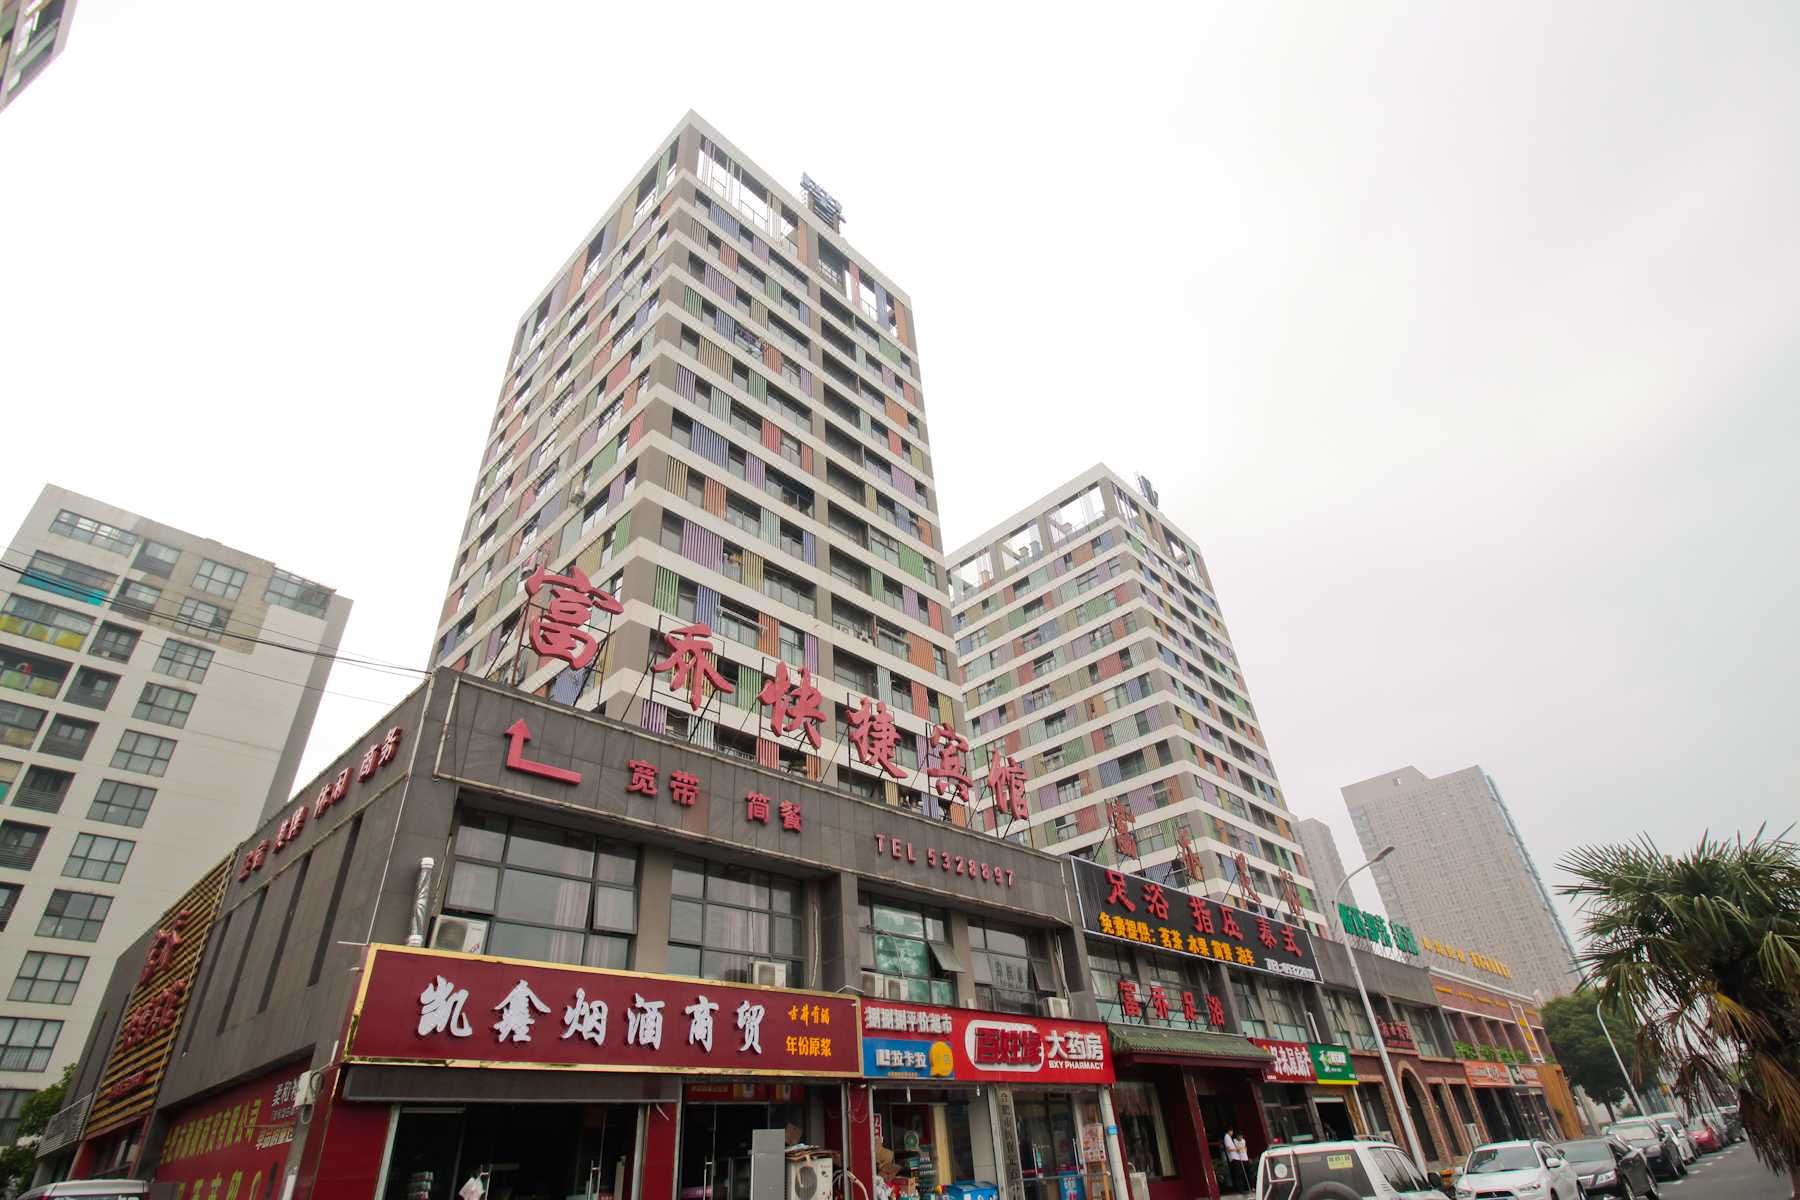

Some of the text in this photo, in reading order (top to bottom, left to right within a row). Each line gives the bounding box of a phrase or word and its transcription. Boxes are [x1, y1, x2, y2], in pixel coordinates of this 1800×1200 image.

[524, 564, 1030, 821] 富乔快捷宾馆
[313, 767, 354, 819] 休闲
[357, 726, 403, 783] 商务
[626, 760, 804, 833] 宽带 简餐
[874, 833, 1014, 886] TEL 5328897
[1106, 868, 1302, 958] 足浴 指压 泰式
[1187, 934, 1211, 957] 水果
[1210, 939, 1234, 963] 简餐
[417, 974, 765, 1055] 凯鑫烟酒商贸
[787, 1003, 831, 1028] 古井贡酒
[1117, 979, 1225, 1026] 富乔足浴
[785, 1034, 833, 1058] 年份原浆
[890, 1048, 928, 1069] 拉卡拉
[934, 1053, 952, 1066] 小店
[1044, 1029, 1105, 1062] 大药房
[1049, 1059, 1105, 1072] BXY PHARMACY
[1000, 1091, 1022, 1200] 合肥市医保定点
